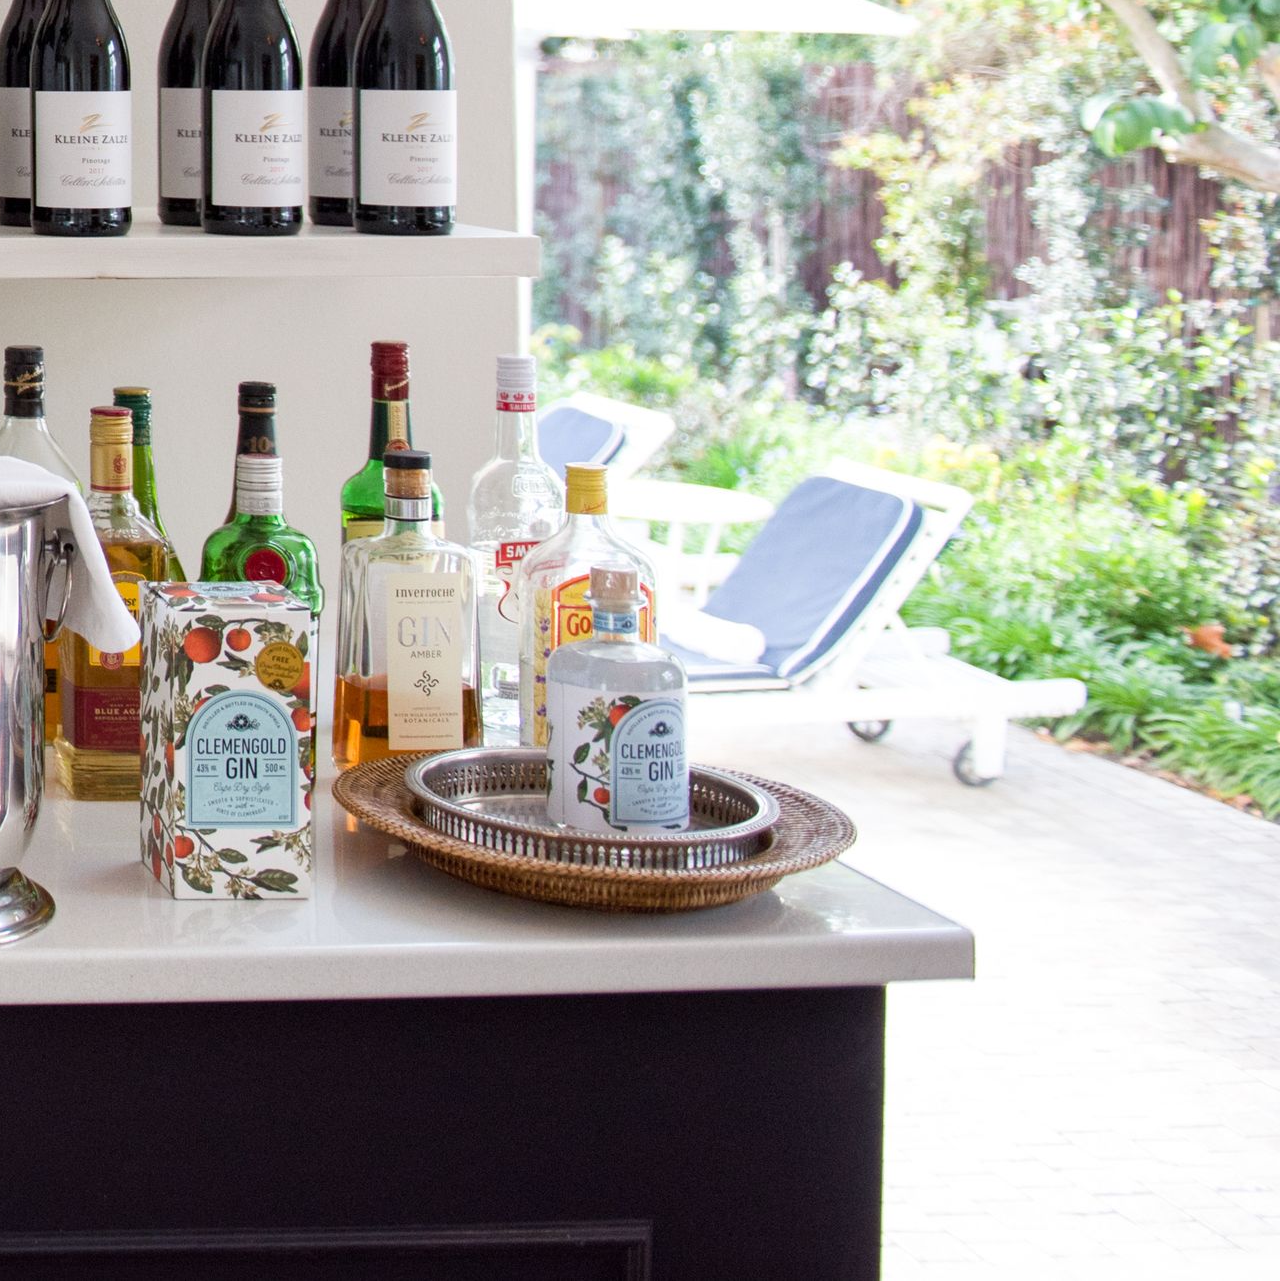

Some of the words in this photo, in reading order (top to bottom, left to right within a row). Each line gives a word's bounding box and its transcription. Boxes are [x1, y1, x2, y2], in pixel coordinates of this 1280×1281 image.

[319, 128, 352, 137] KLEIN
[381, 132, 427, 142] KLEINE
[54, 134, 99, 144] KLEINE
[101, 134, 128, 144] ZALZE
[234, 133, 279, 143] KLEINE
[248, 436, 270, 453] 10
[397, 616, 451, 648] GIN
[271, 655, 289, 663] FREE
[410, 650, 443, 659] AMBER
[94, 708, 121, 716] BLUE
[196, 738, 287, 755] CLEMENGOLD
[225, 757, 258, 779] GIN
[265, 764, 278, 773] 500
[648, 760, 674, 782] GIN
